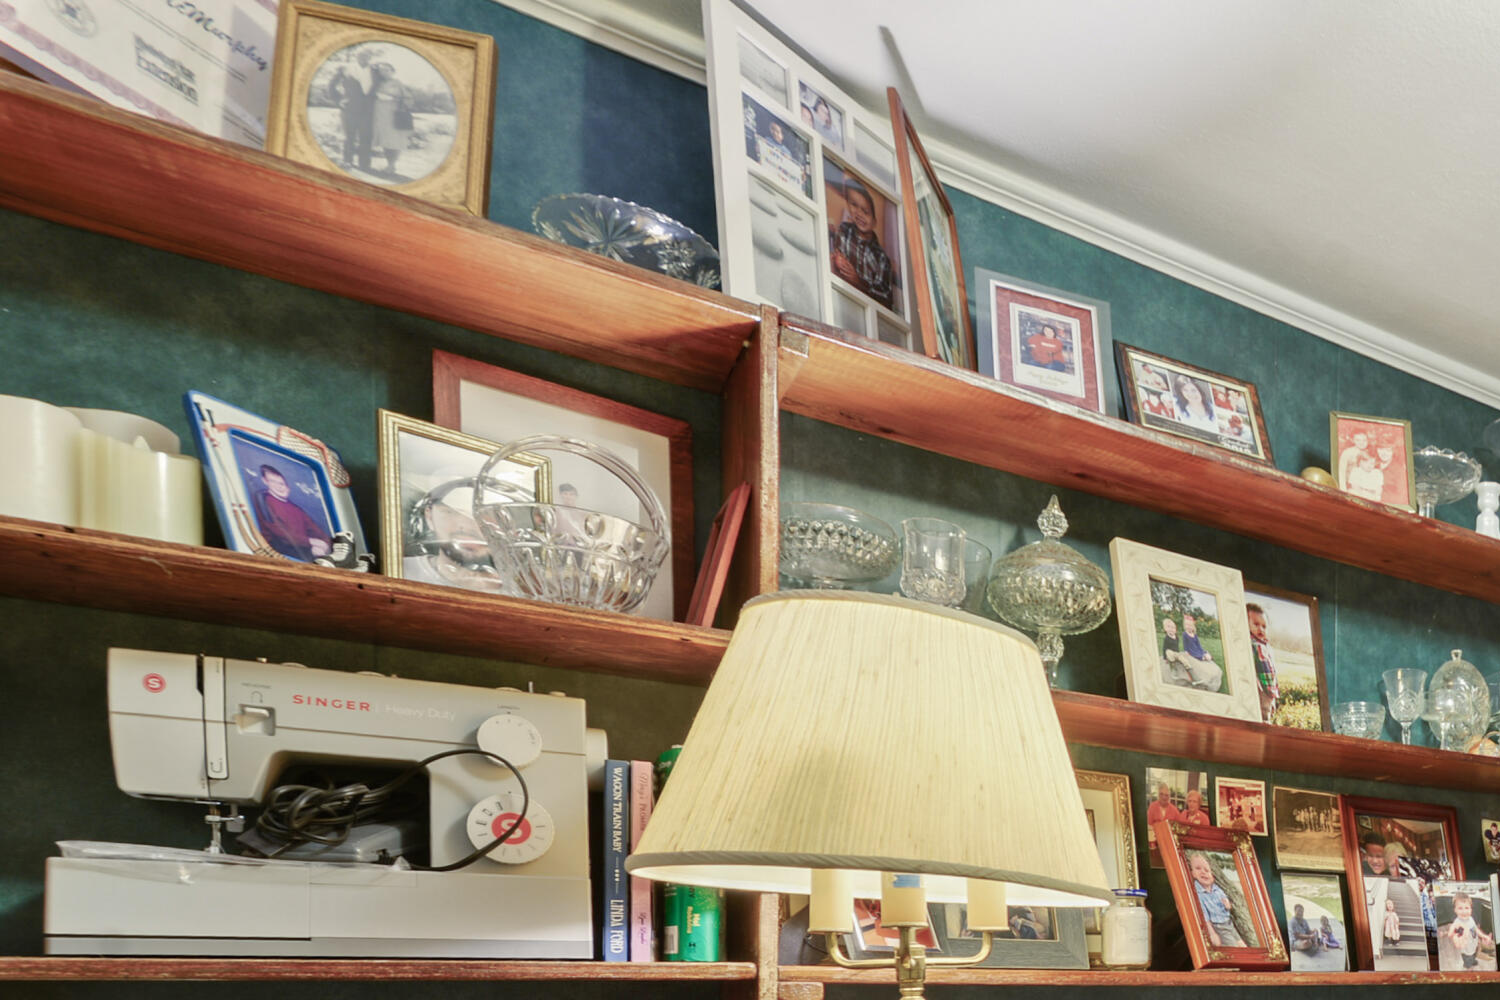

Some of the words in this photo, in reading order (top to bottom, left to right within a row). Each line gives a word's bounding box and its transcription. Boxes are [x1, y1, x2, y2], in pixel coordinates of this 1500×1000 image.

[292, 693, 371, 712] SINGER
[385, 703, 425, 719] Heavy
[426, 707, 457, 722] Duty
[612, 767, 623, 802] WAGON
[612, 802, 623, 829] TRAIN
[612, 829, 623, 853] BABY
[610, 899, 624, 927] LINDA
[610, 929, 624, 955] FORD
